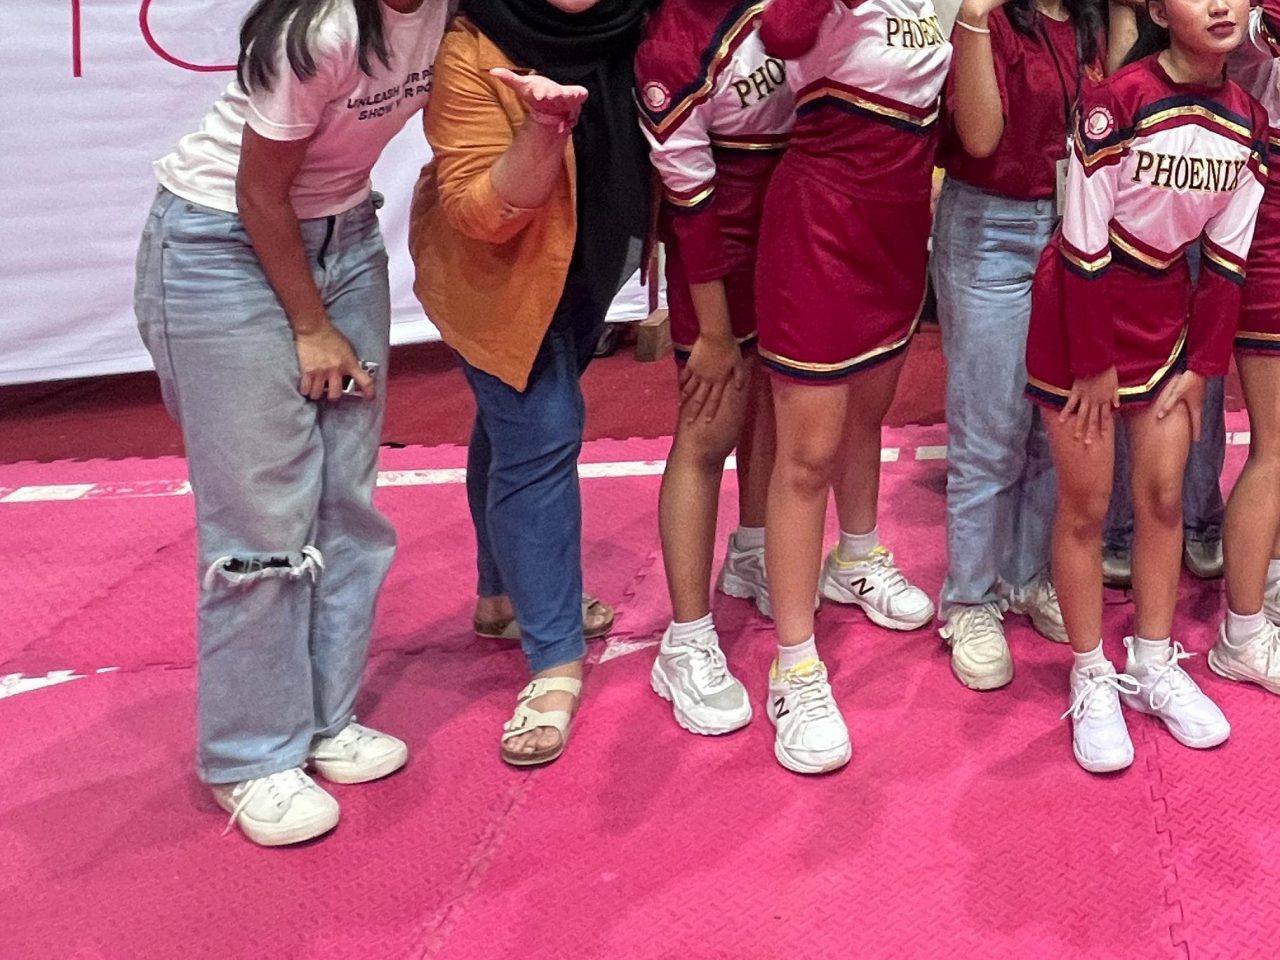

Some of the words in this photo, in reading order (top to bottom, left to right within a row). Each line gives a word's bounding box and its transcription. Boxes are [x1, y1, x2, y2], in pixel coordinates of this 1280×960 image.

[347, 86, 400, 109] UNLEASH
[358, 101, 394, 120] SHOW
[1132, 150, 1245, 192] PHOENIX
